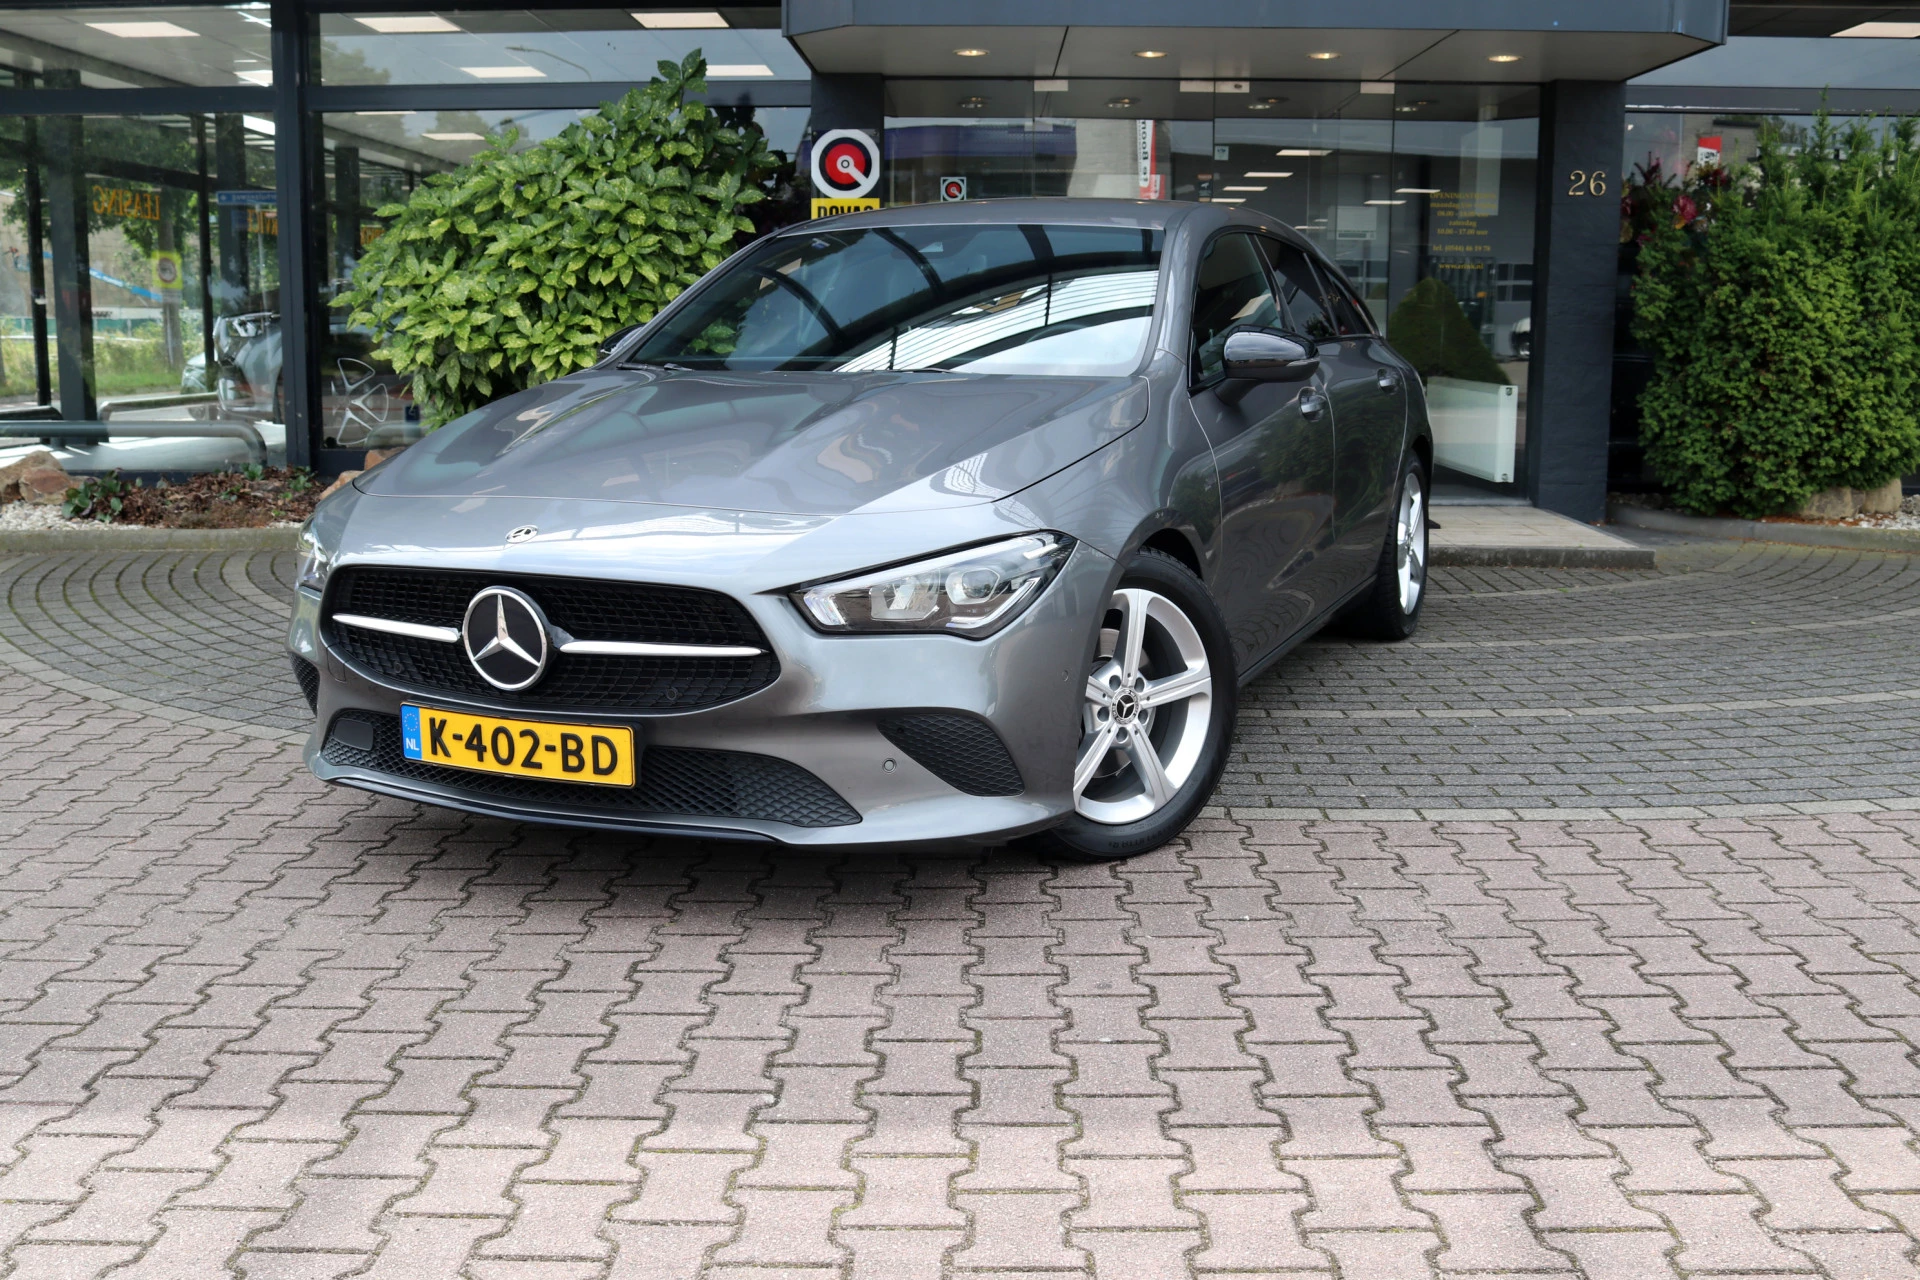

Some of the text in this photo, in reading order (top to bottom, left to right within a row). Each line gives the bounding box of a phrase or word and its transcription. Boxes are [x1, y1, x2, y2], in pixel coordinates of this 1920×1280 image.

[1568, 170, 1606, 196] 26
[405, 737, 420, 751] NL
[429, 716, 618, 776] K-402-BD
